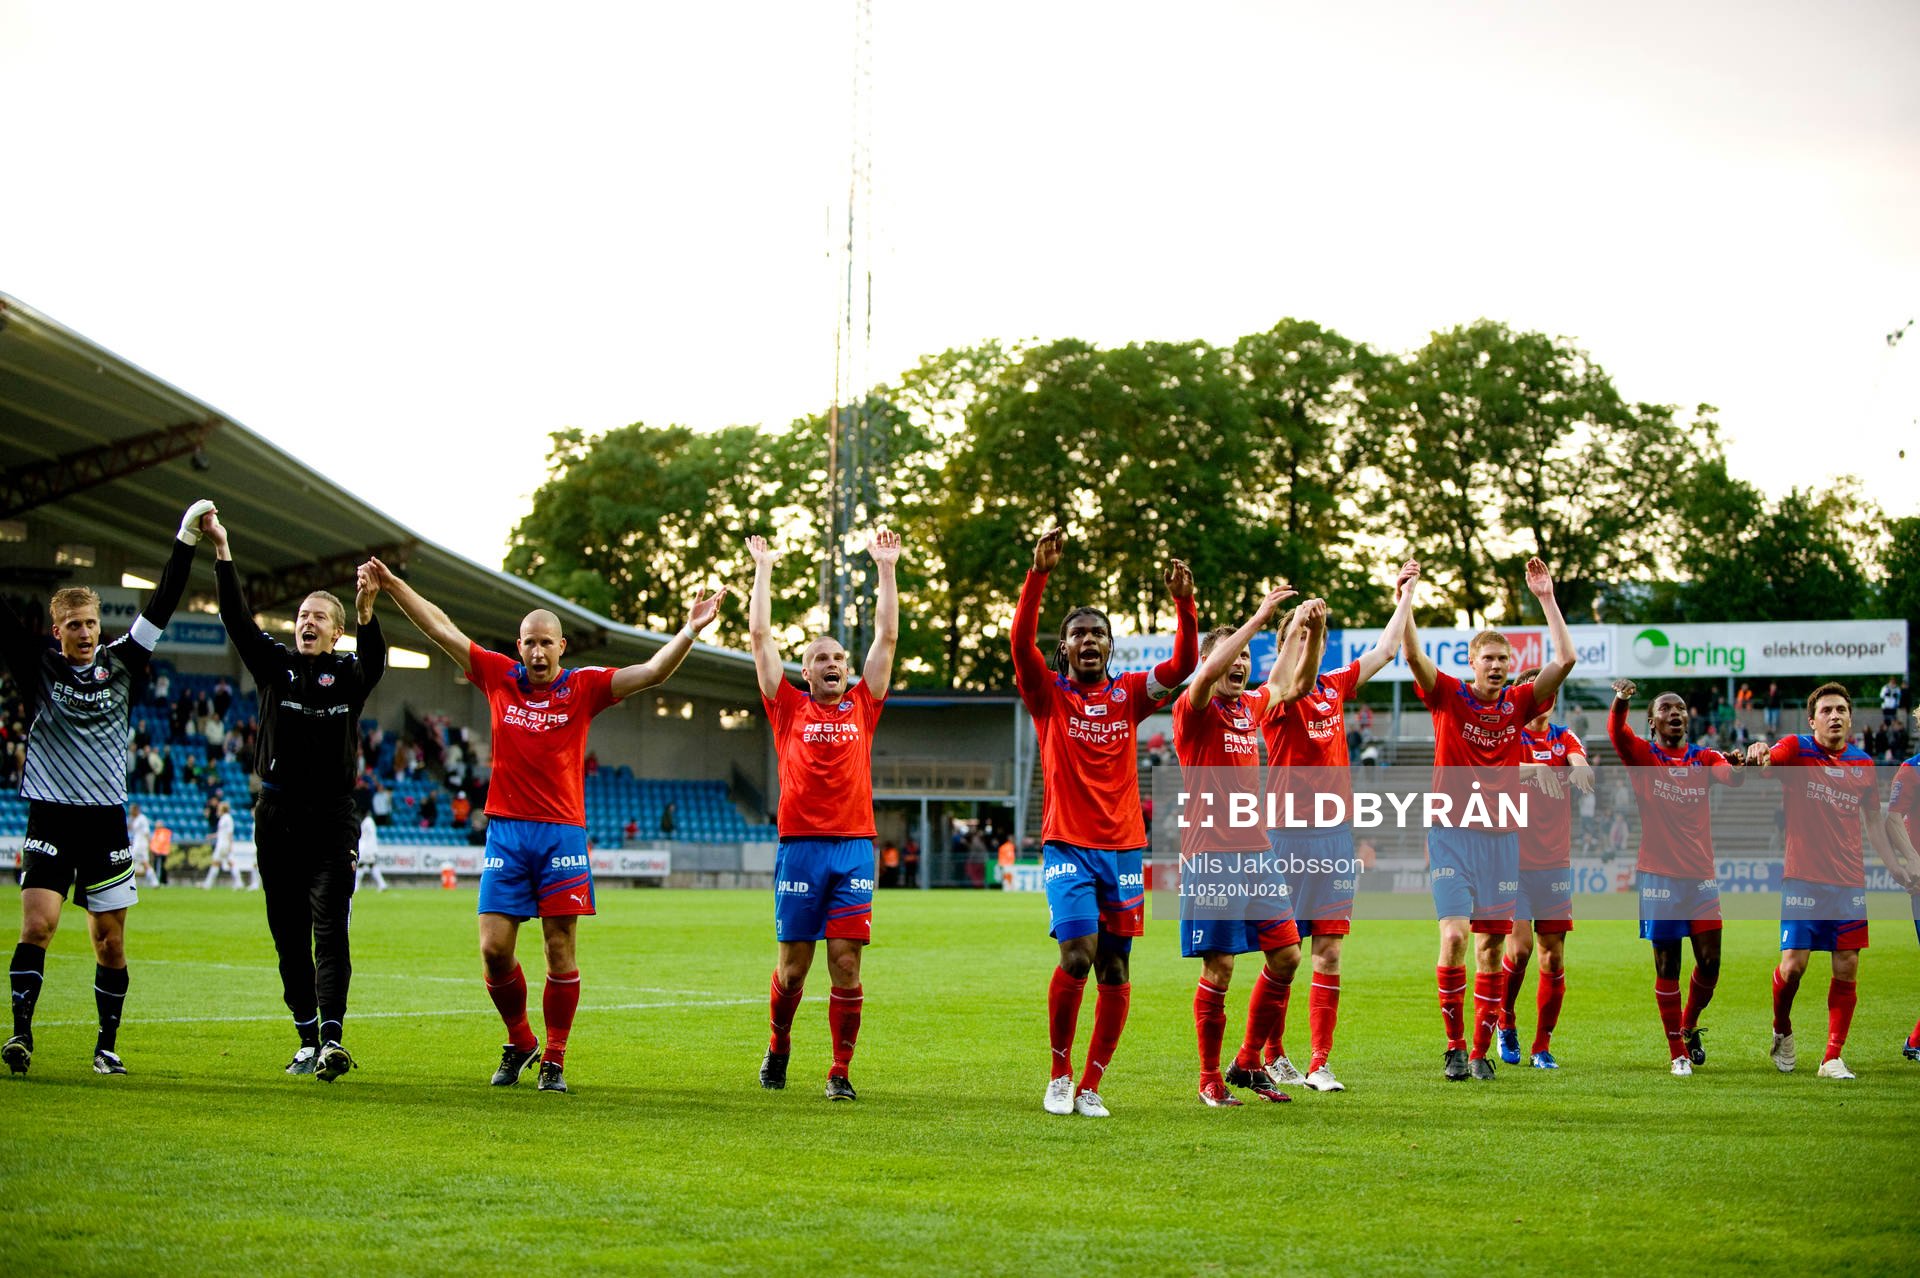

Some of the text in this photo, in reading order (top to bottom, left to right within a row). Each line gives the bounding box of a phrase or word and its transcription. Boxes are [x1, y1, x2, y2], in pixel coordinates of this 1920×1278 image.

[1763, 640, 1886, 657] elektrokoppar
[1674, 642, 1745, 672] bring
[53, 681, 111, 702] RESURS
[507, 705, 569, 723] RESURS
[503, 715, 542, 731] BANK
[804, 723, 859, 732] RESURS
[1069, 716, 1129, 733] RESURS
[803, 733, 840, 743] BANK
[1068, 728, 1108, 743] BANK
[1308, 728, 1334, 739] BANK
[1462, 731, 1497, 748] BANK
[1224, 743, 1253, 755] BANK
[1654, 779, 1706, 796] RESURS
[1808, 781, 1859, 804] RESURS
[1653, 789, 1685, 804] BANK
[1806, 790, 1837, 807] BANK
[24, 838, 58, 857] SOLID
[483, 857, 504, 869] LID
[1045, 863, 1077, 880] SOLID
[1194, 894, 1228, 907] OLID
[1643, 888, 1671, 899] SOLID
[1785, 896, 1816, 907] SOLID
